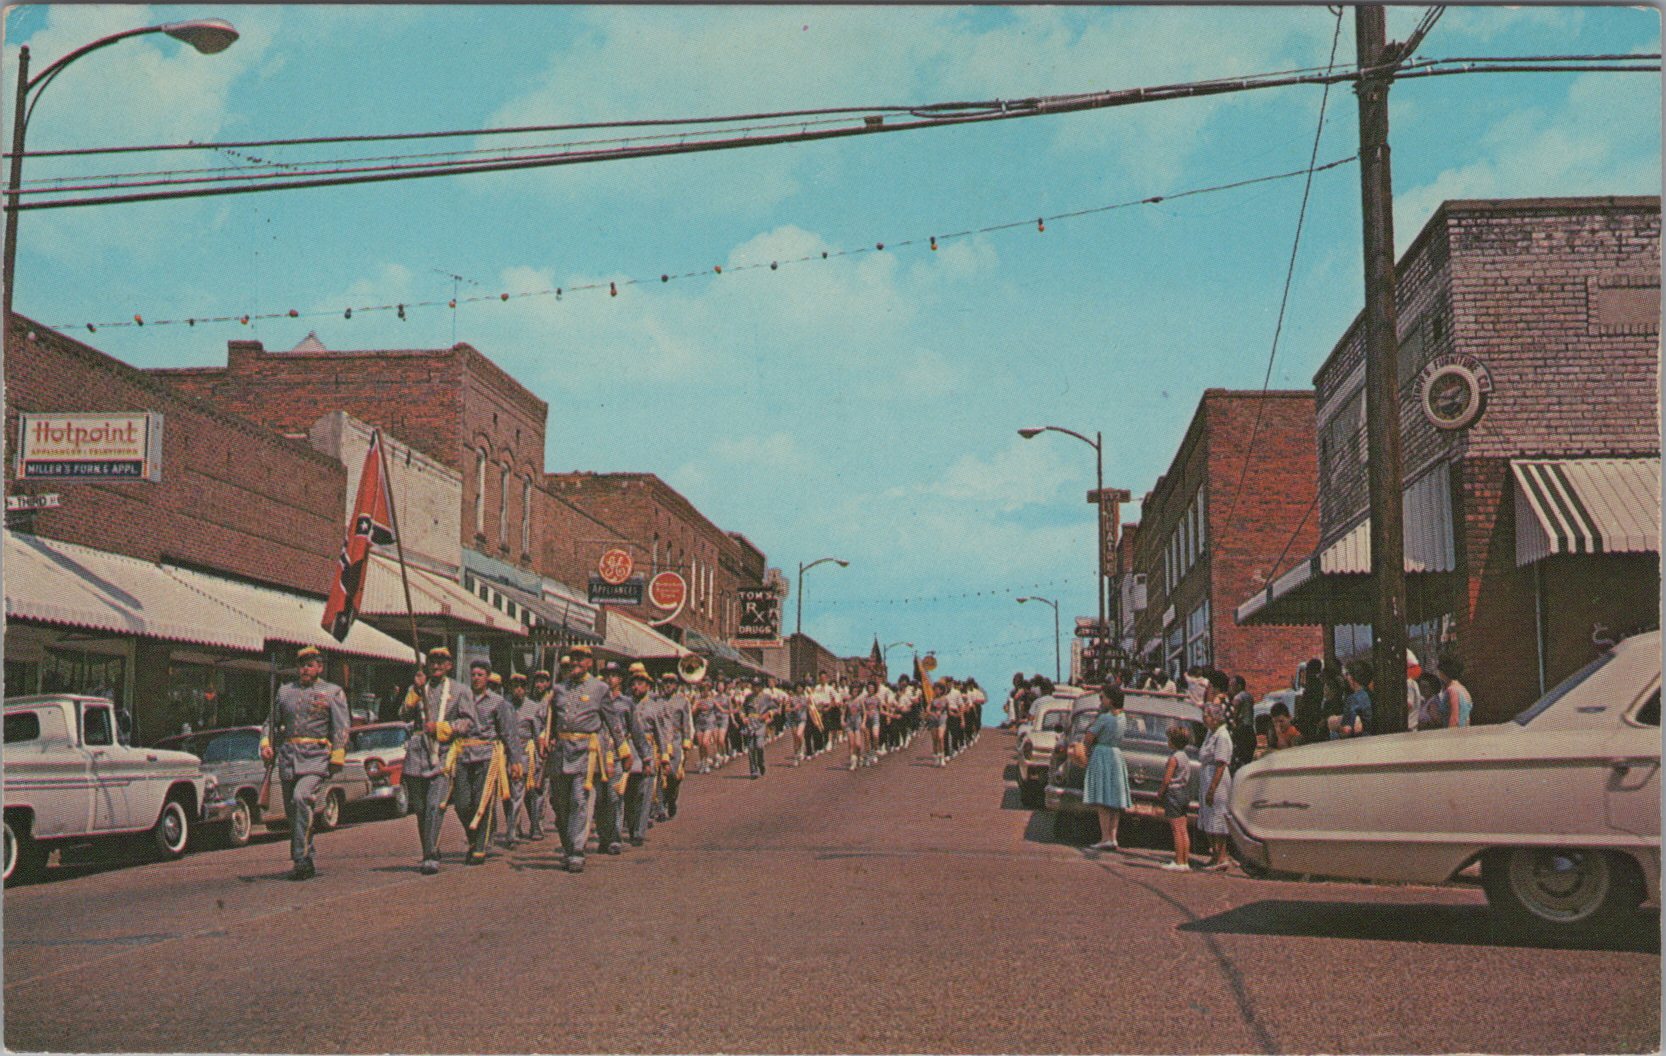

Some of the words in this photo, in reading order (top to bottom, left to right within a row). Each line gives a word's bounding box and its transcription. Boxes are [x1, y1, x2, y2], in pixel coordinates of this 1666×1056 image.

[32, 421, 138, 447] Hotpoint
[27, 463, 71, 474] MILLER'S
[738, 625, 771, 635] DRUGS
